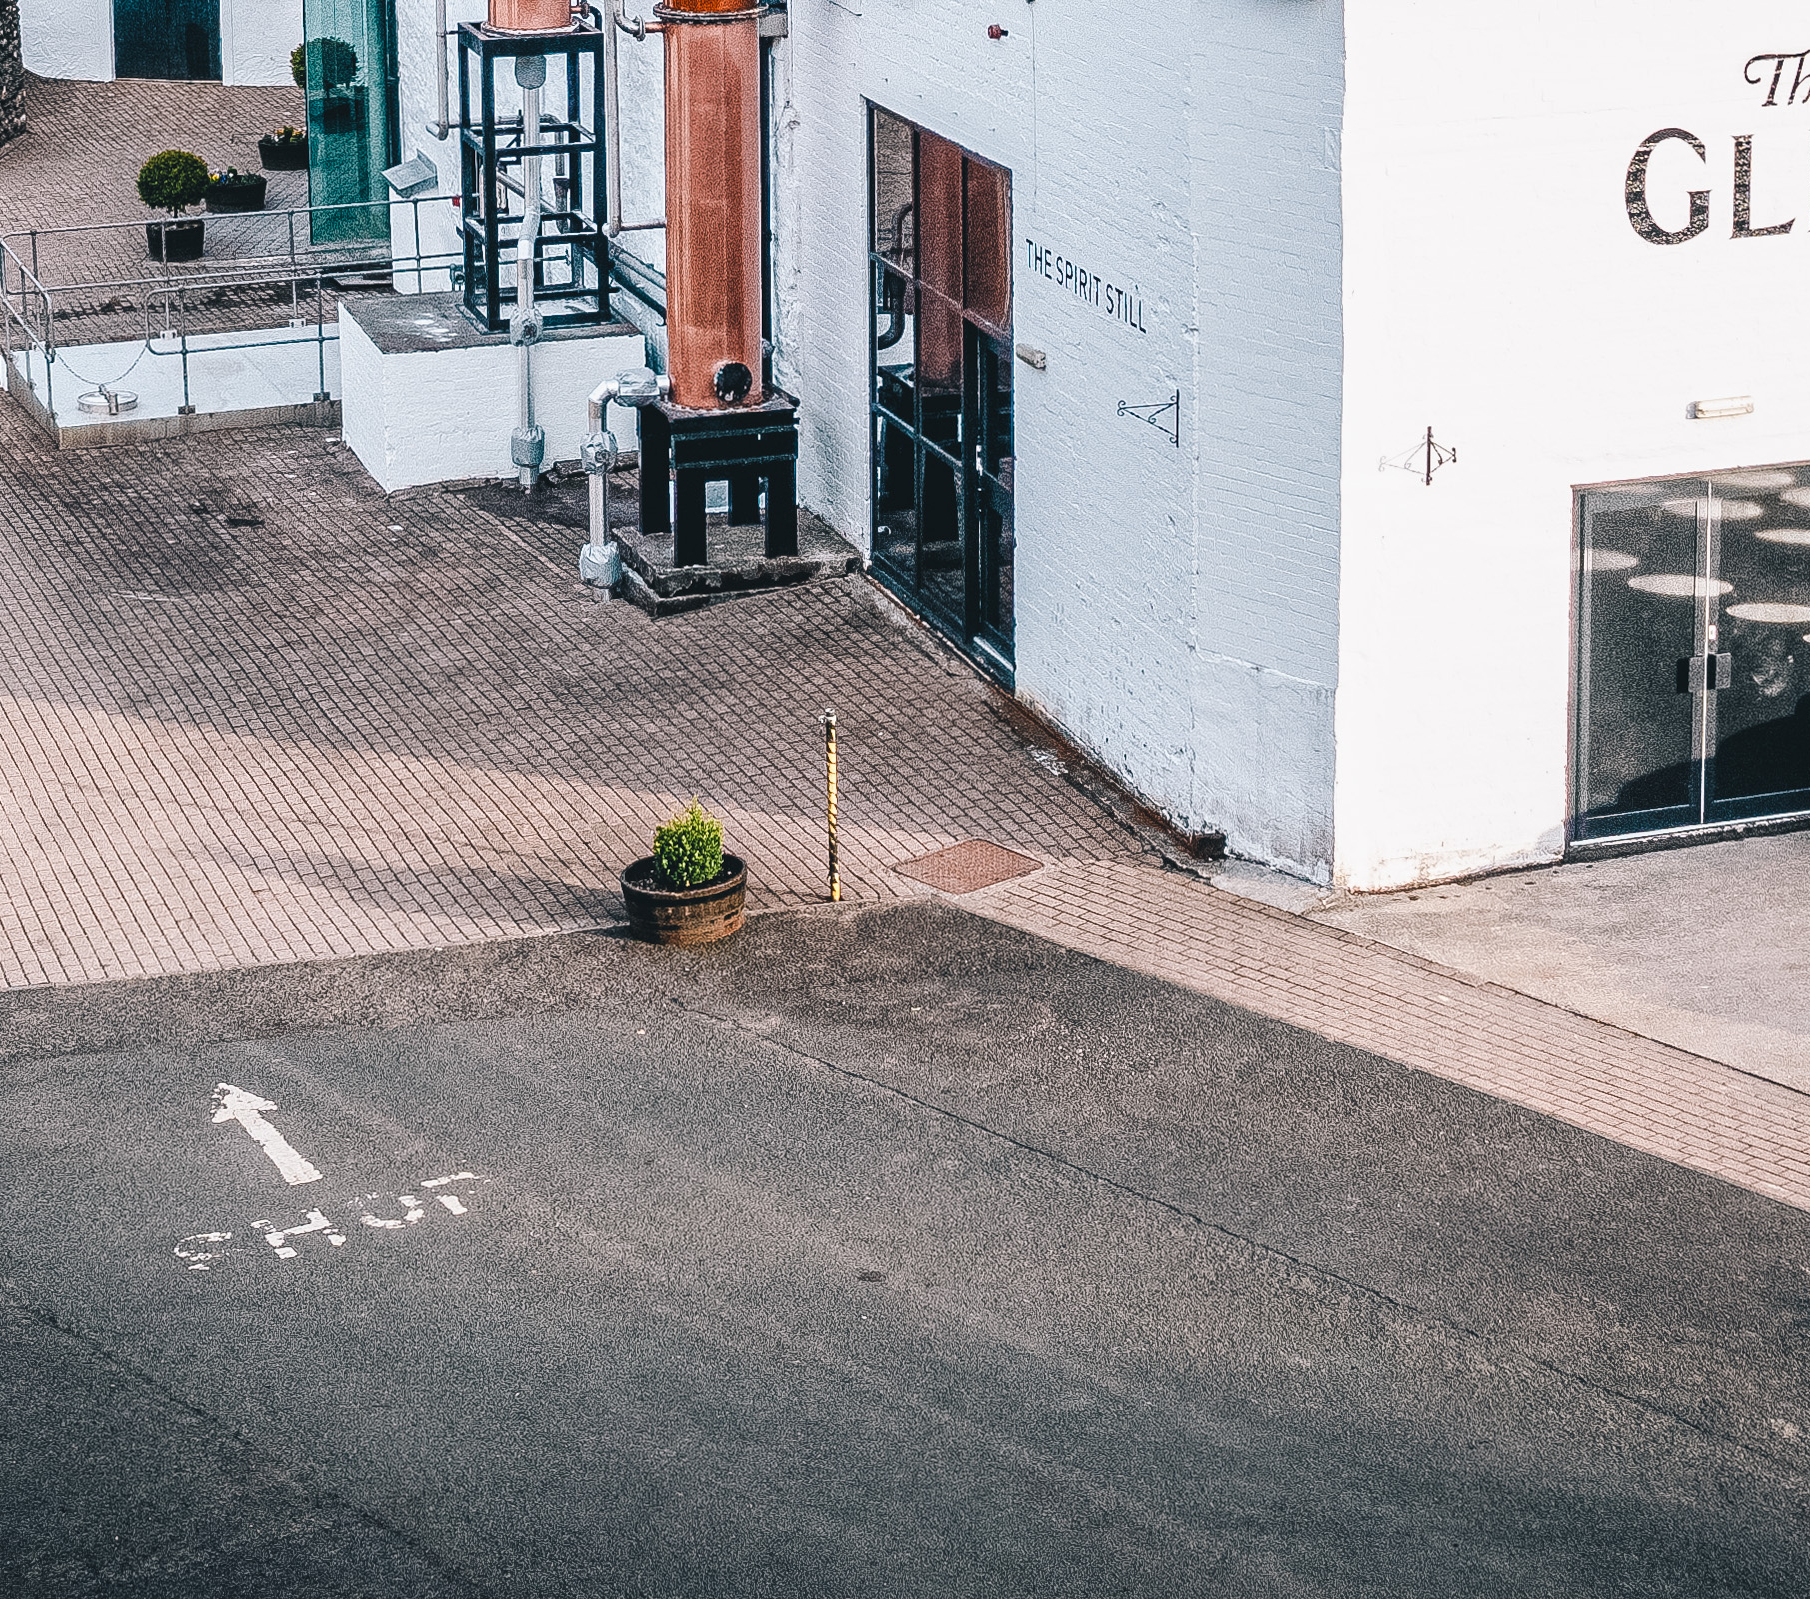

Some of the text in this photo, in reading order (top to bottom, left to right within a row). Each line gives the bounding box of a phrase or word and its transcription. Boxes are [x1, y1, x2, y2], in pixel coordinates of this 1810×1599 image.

[1026, 238, 1147, 334] THE SPIRIT STILL
